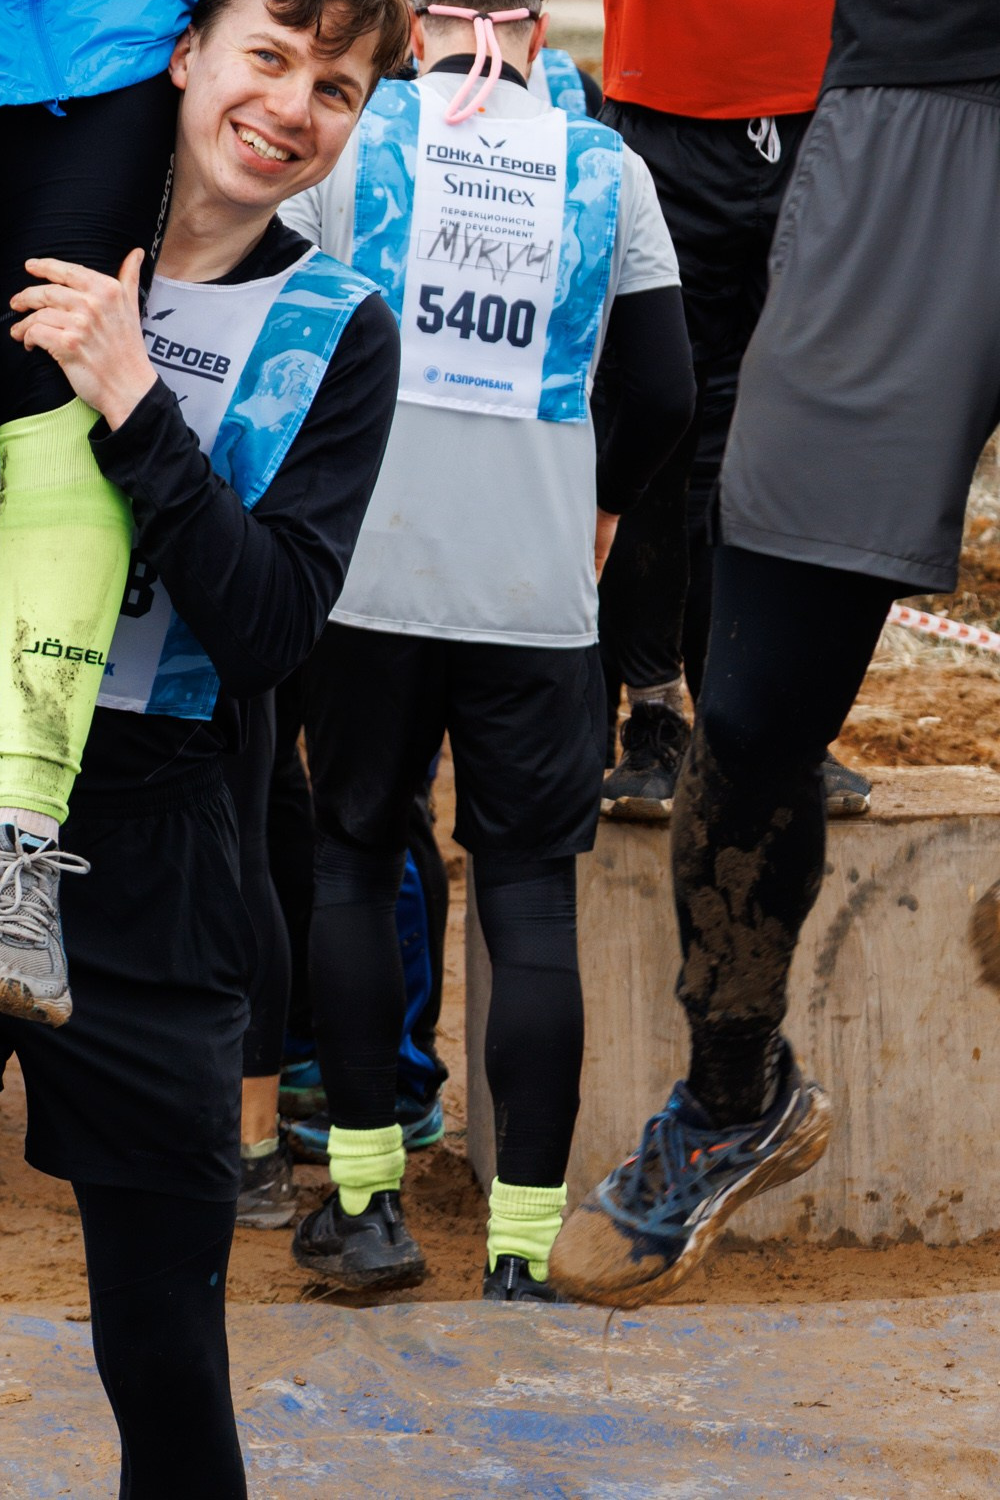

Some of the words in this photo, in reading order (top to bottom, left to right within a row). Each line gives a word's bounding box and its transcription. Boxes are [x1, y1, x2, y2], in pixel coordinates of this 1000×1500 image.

[426, 144, 484, 165] ГОНКА
[490, 155, 557, 176] ГЕРОЕВ
[443, 173, 535, 207] Sminex
[441, 206, 535, 227] ПЕРФЕКЦИОНИСТЫ
[465, 222, 534, 239] DEVELOPMENT
[416, 284, 536, 348] 5400
[143, 329, 231, 375] ГЕРОЕВ
[444, 372, 514, 392] ГАЗПРОМБАНК
[22, 637, 105, 666] JÖGEL
